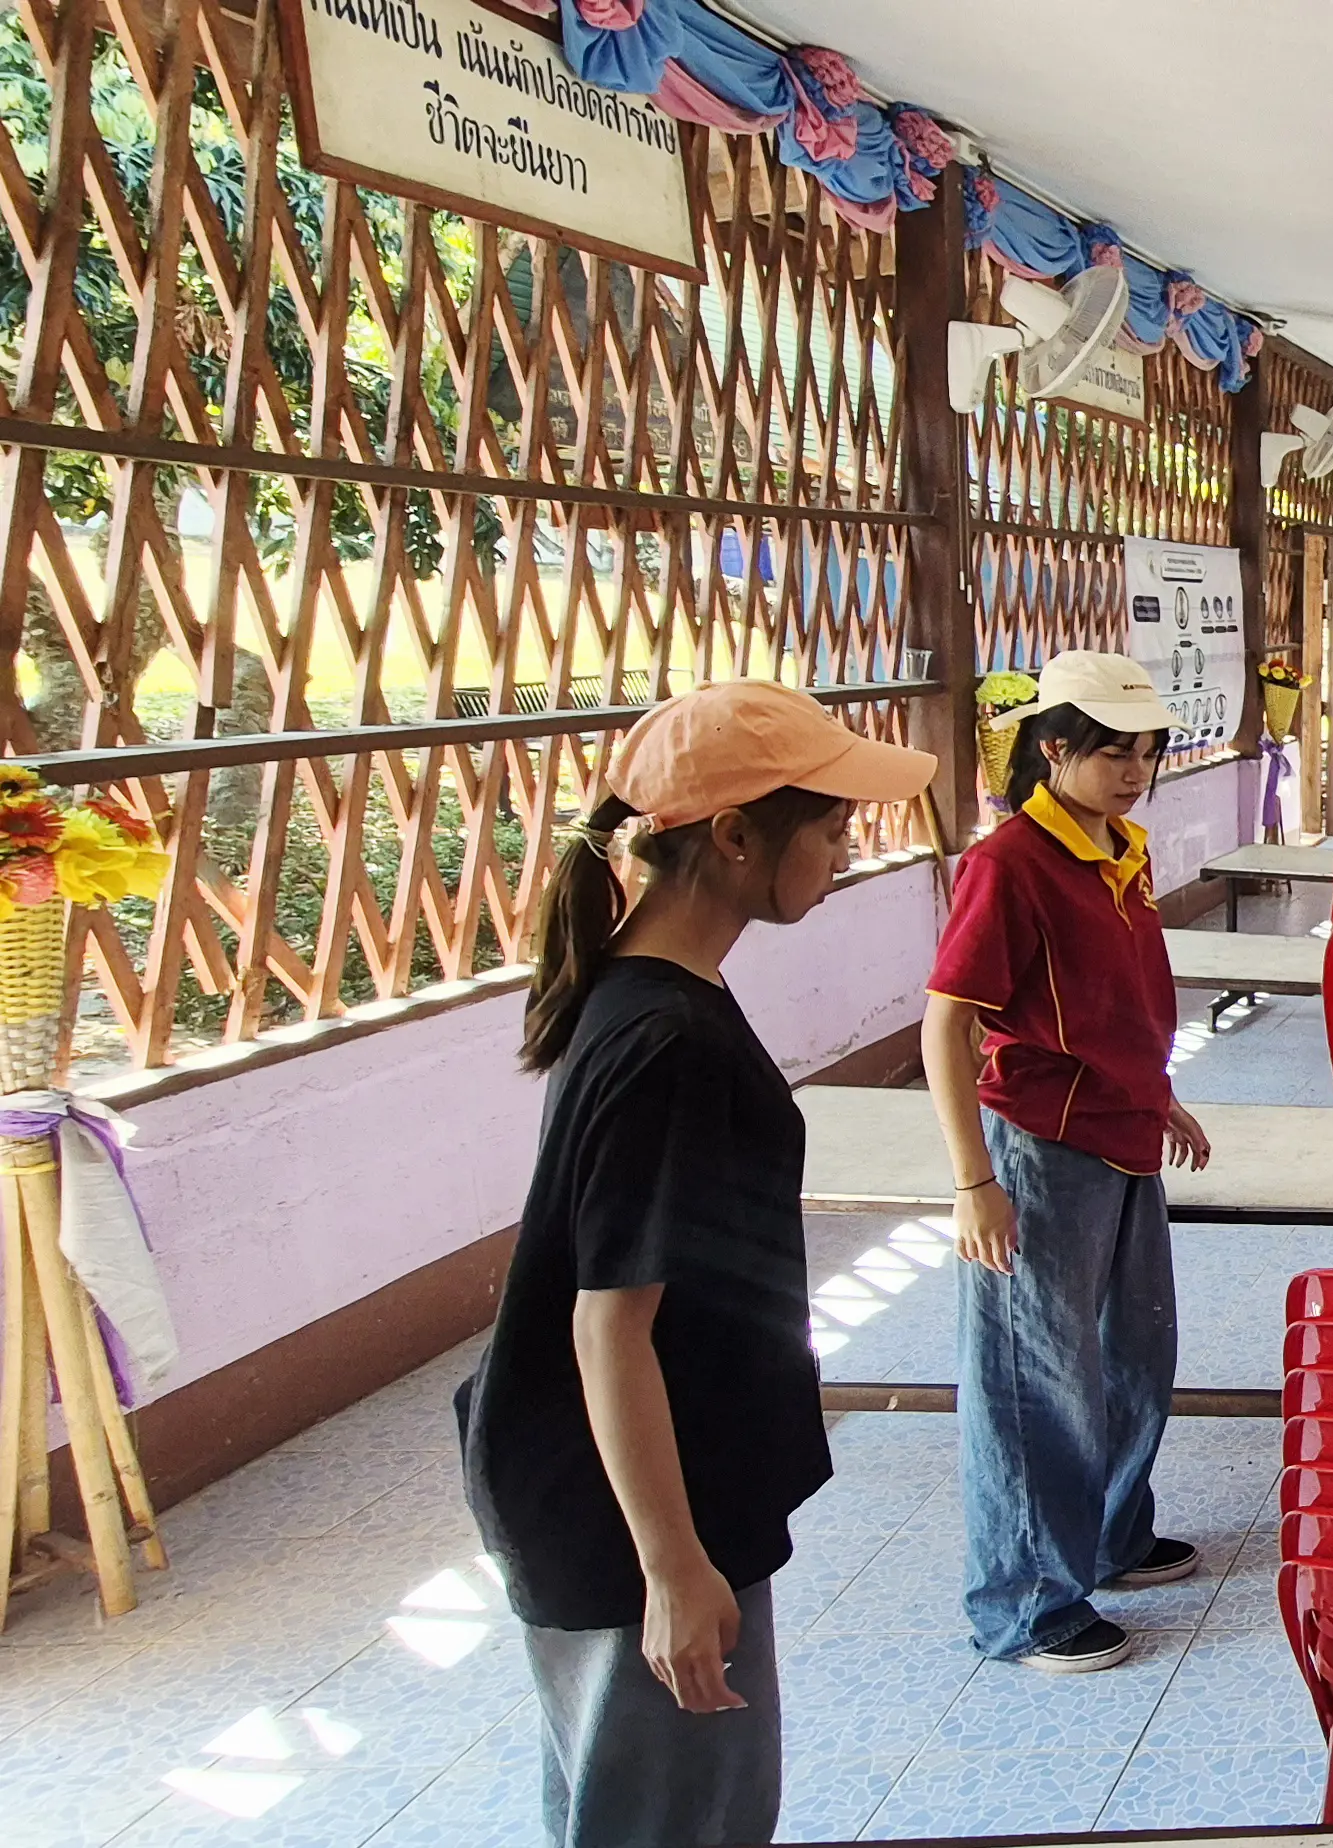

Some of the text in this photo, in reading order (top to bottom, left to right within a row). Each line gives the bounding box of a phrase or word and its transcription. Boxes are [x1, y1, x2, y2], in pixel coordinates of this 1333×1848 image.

[423, 79, 588, 194] ชีวิตจะยืนยาว
[456, 21, 677, 156] เน้นผักปลอดสารพิษ
